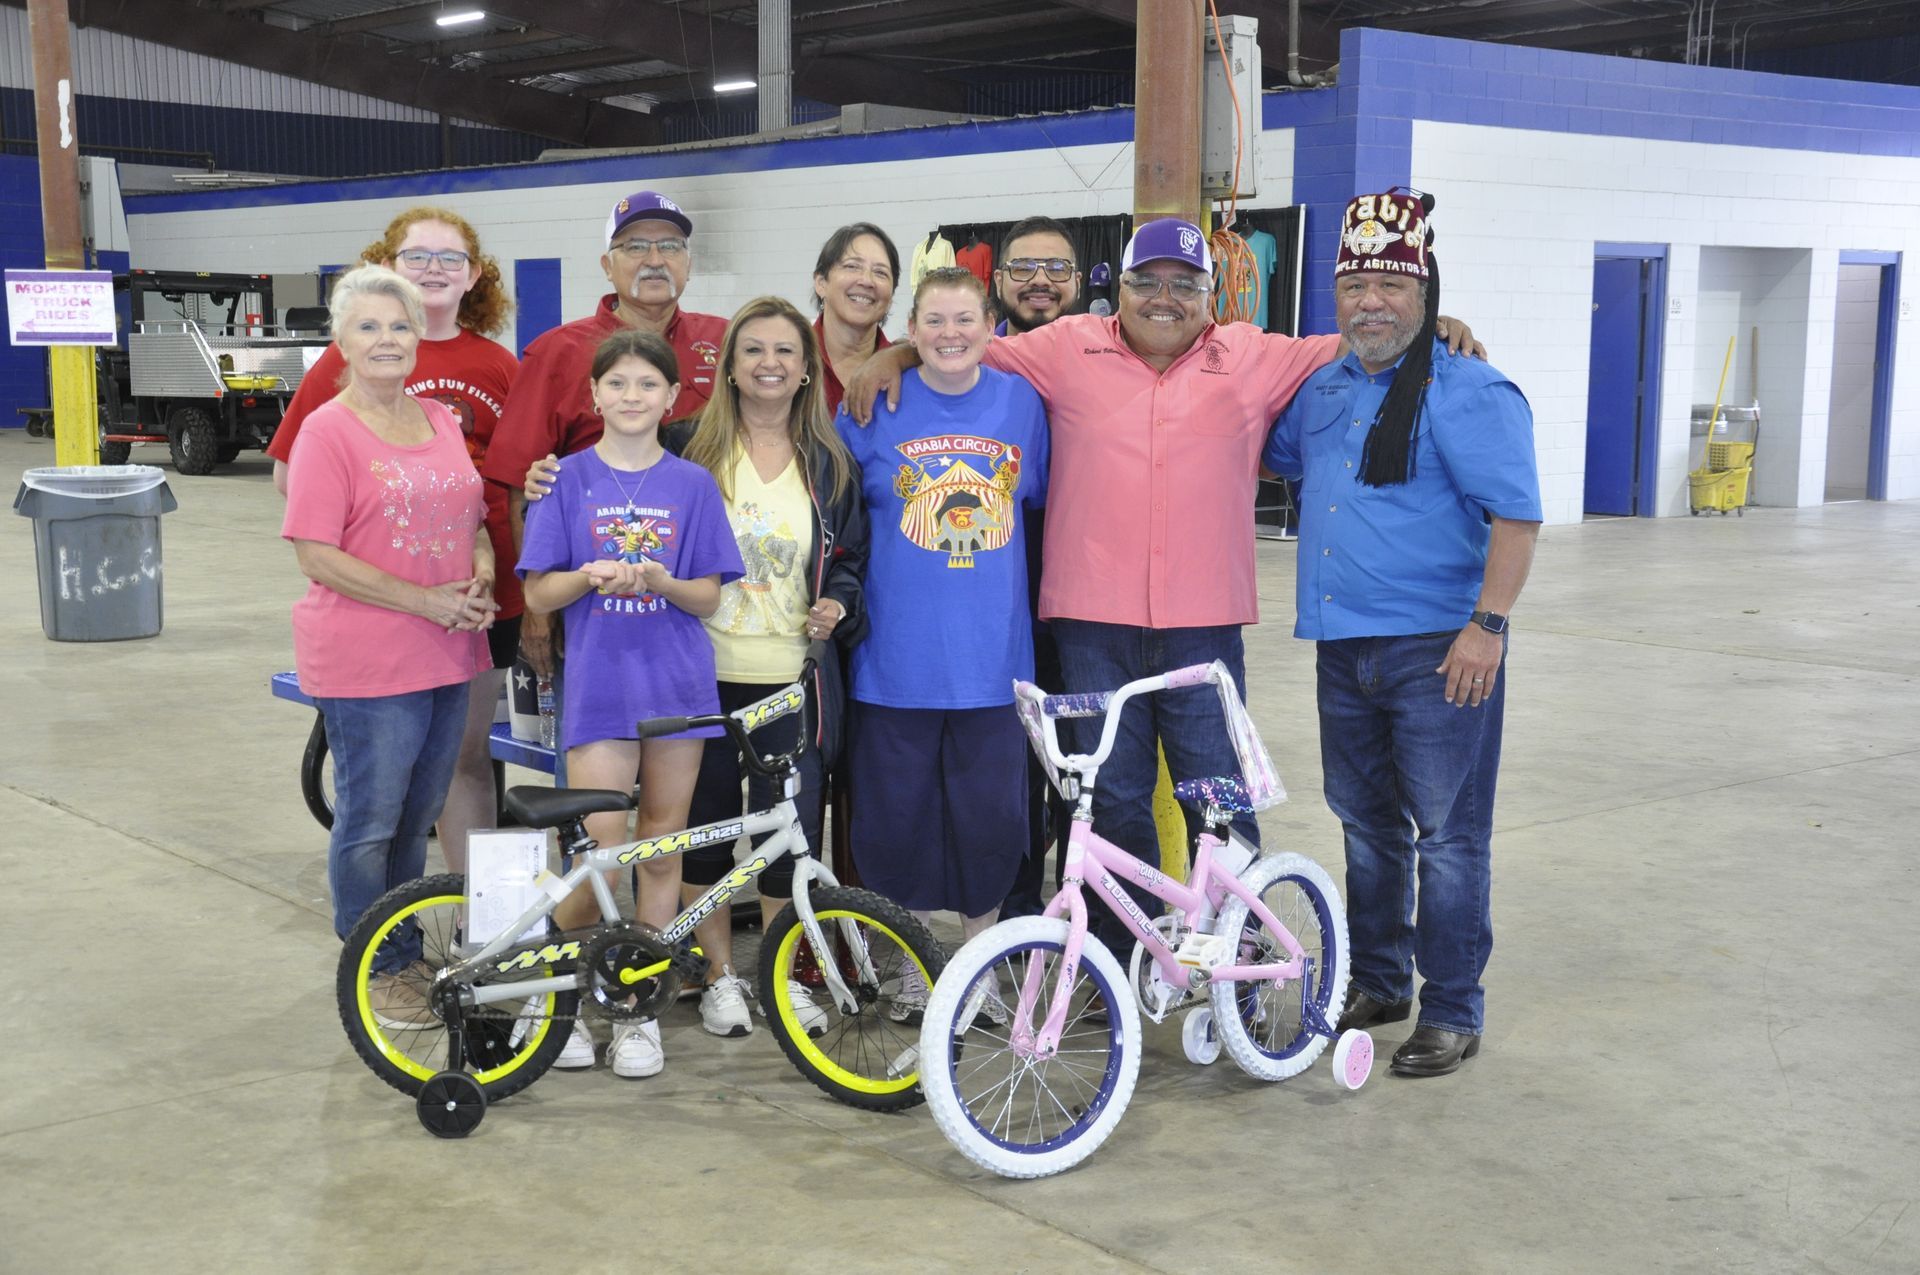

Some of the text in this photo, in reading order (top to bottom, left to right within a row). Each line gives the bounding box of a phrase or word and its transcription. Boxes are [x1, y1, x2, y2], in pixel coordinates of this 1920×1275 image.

[1363, 259, 1420, 274] AGITATOR
[15, 284, 105, 294] MONSTER
[30, 297, 92, 306] TRUCK
[36, 310, 90, 320] RIDES
[404, 379, 436, 396] RING
[438, 378, 466, 391] FUN
[907, 438, 999, 456] ARABIA CIRCUS
[597, 506, 671, 519] ARABIA SHRINE
[603, 597, 668, 613] CIRCUS
[690, 823, 743, 846] BLAZE
